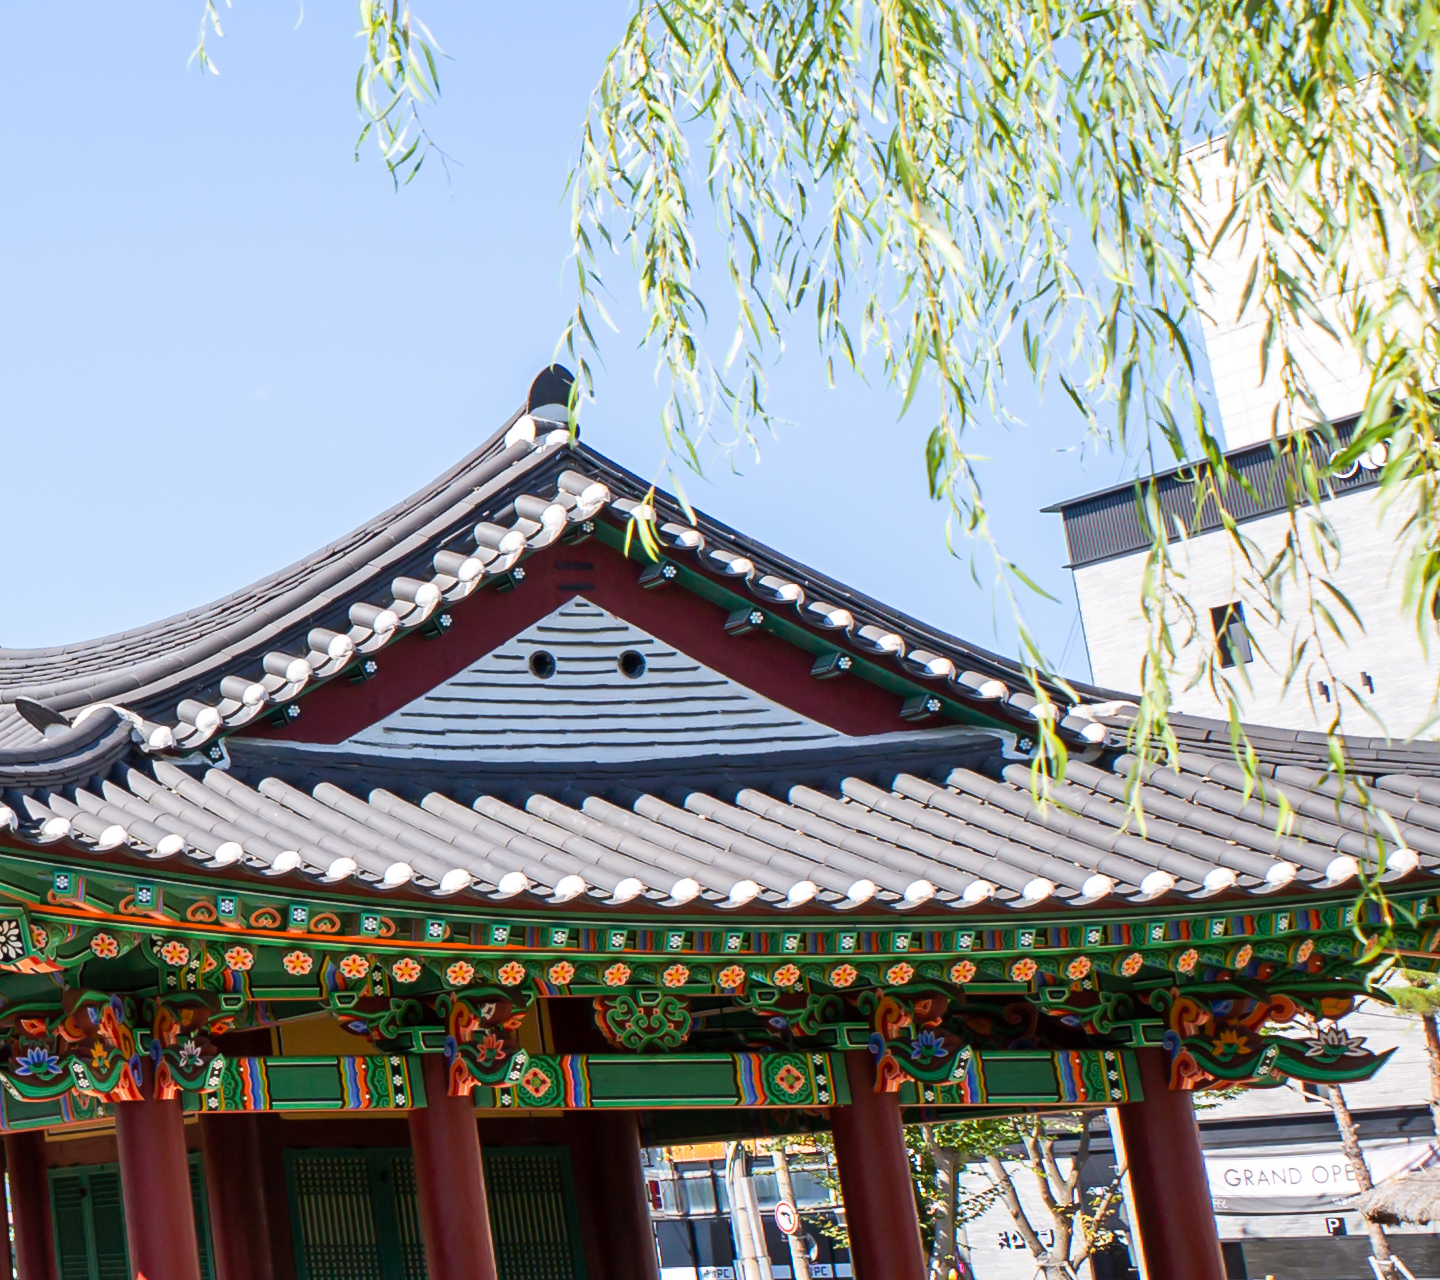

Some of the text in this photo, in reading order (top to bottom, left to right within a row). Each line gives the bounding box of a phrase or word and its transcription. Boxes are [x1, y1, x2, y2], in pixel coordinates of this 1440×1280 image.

[1224, 1163, 1359, 1187] GRAND OPE
[1329, 1218, 1340, 1235] P
